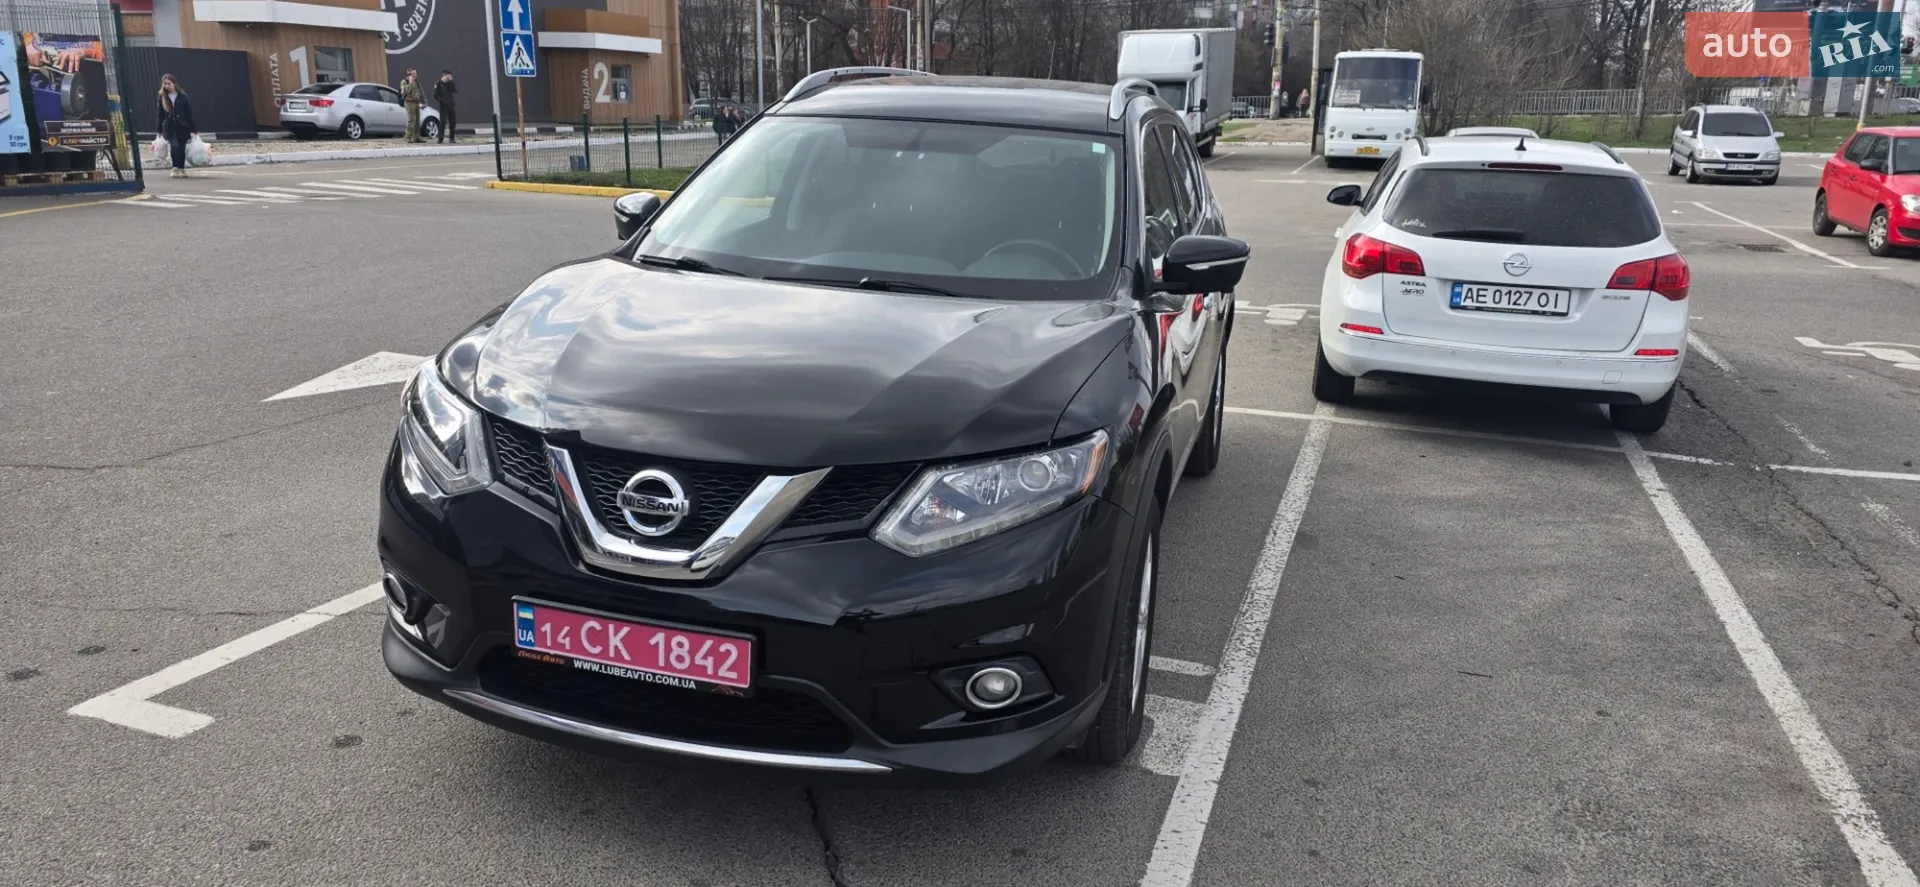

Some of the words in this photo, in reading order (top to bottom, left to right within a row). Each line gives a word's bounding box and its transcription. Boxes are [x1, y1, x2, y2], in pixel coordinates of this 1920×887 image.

[270, 53, 281, 107] ОПЛАТА
[289, 46, 309, 88] 1
[594, 62, 610, 102] 2
[1463, 287, 1488, 304] AE
[1492, 289, 1533, 306] 0127
[621, 496, 679, 512] NISSAN
[518, 629, 534, 643] UA
[540, 622, 571, 650] 14
[580, 620, 631, 661] CK
[648, 632, 738, 679] 1842
[573, 659, 696, 690] WWW.LUBEAVTO.COM.UA
